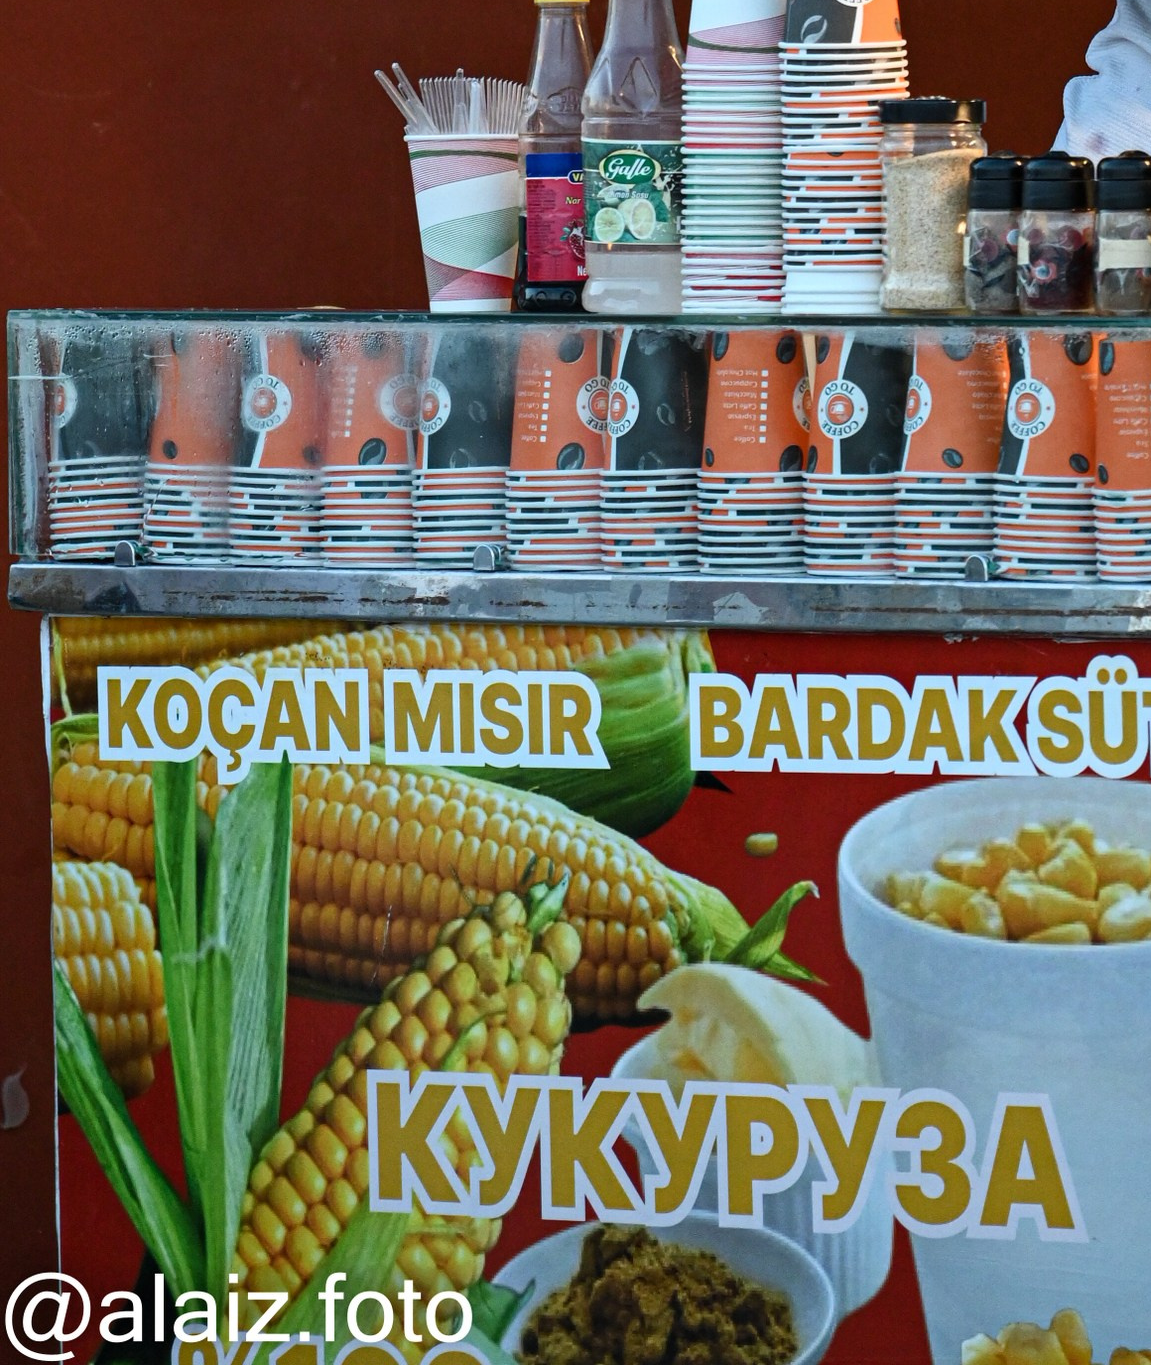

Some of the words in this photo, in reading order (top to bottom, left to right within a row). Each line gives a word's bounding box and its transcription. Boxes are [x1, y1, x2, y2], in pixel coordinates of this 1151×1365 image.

[584, 379, 599, 392] GO
[824, 382, 838, 396] GO
[840, 382, 855, 395] TO
[1014, 382, 1027, 396] GO
[1029, 382, 1043, 396] TO
[822, 420, 859, 436] COFFEE
[1011, 421, 1046, 437] COFFEE
[104, 677, 363, 773] KOÇAN
[394, 680, 594, 757] MISIR
[699, 682, 1021, 764] BARDAK
[377, 1082, 1077, 1231] КУКУРУЗА
